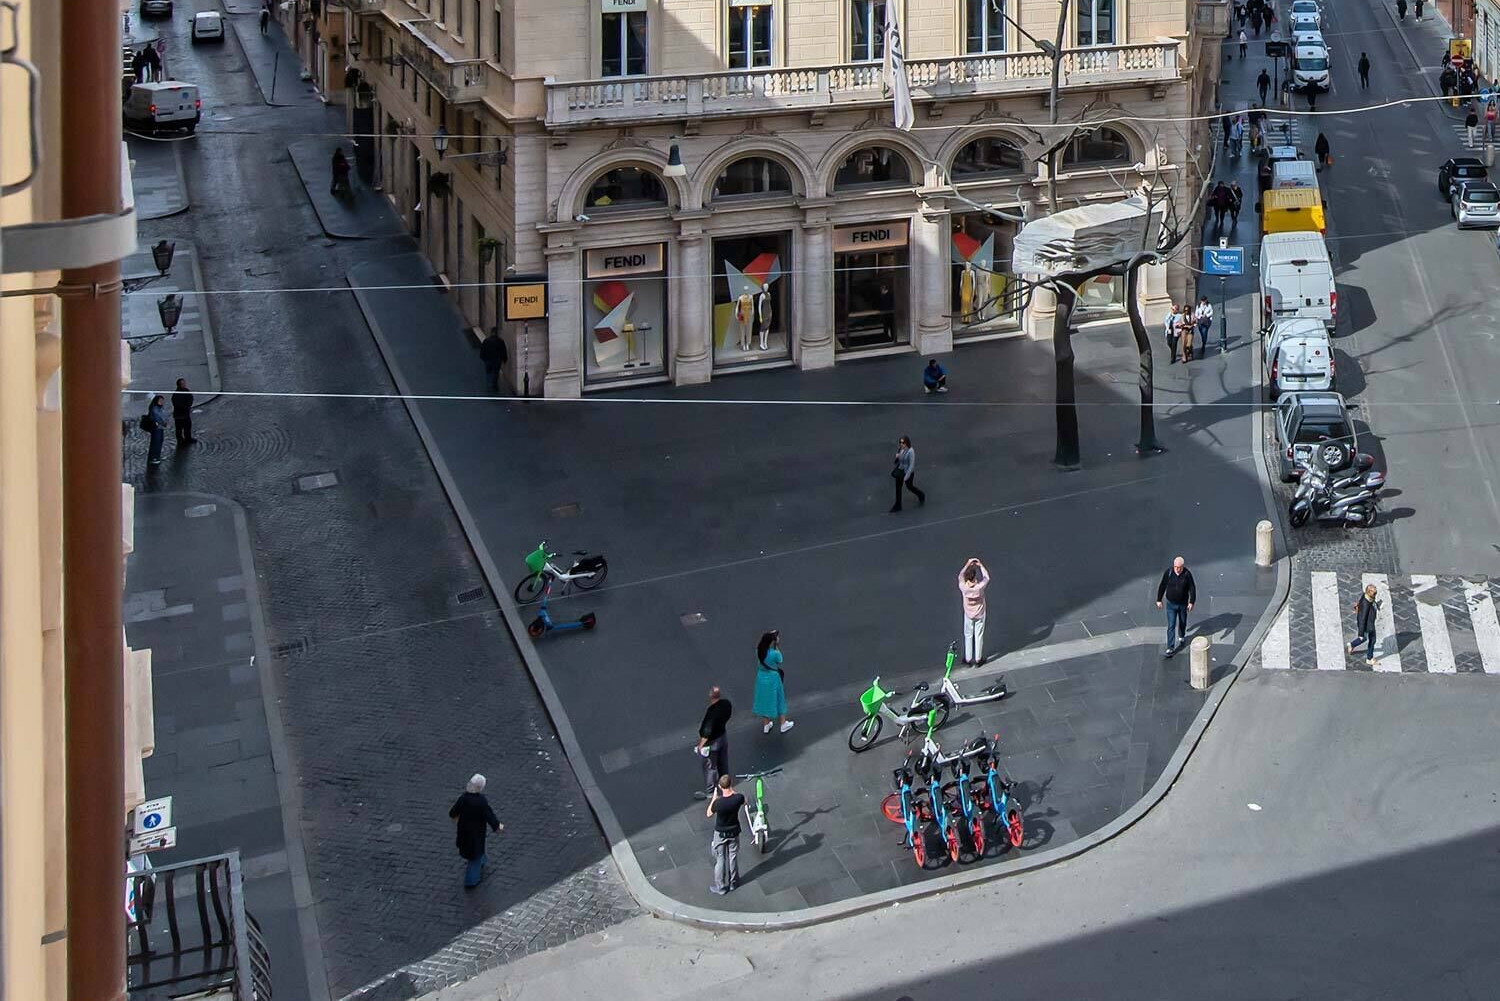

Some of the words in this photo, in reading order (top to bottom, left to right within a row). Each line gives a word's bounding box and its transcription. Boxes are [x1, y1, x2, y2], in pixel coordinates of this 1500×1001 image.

[852, 229, 890, 243] FENDI
[604, 254, 646, 269] FENDI
[513, 296, 538, 304] FENDI
